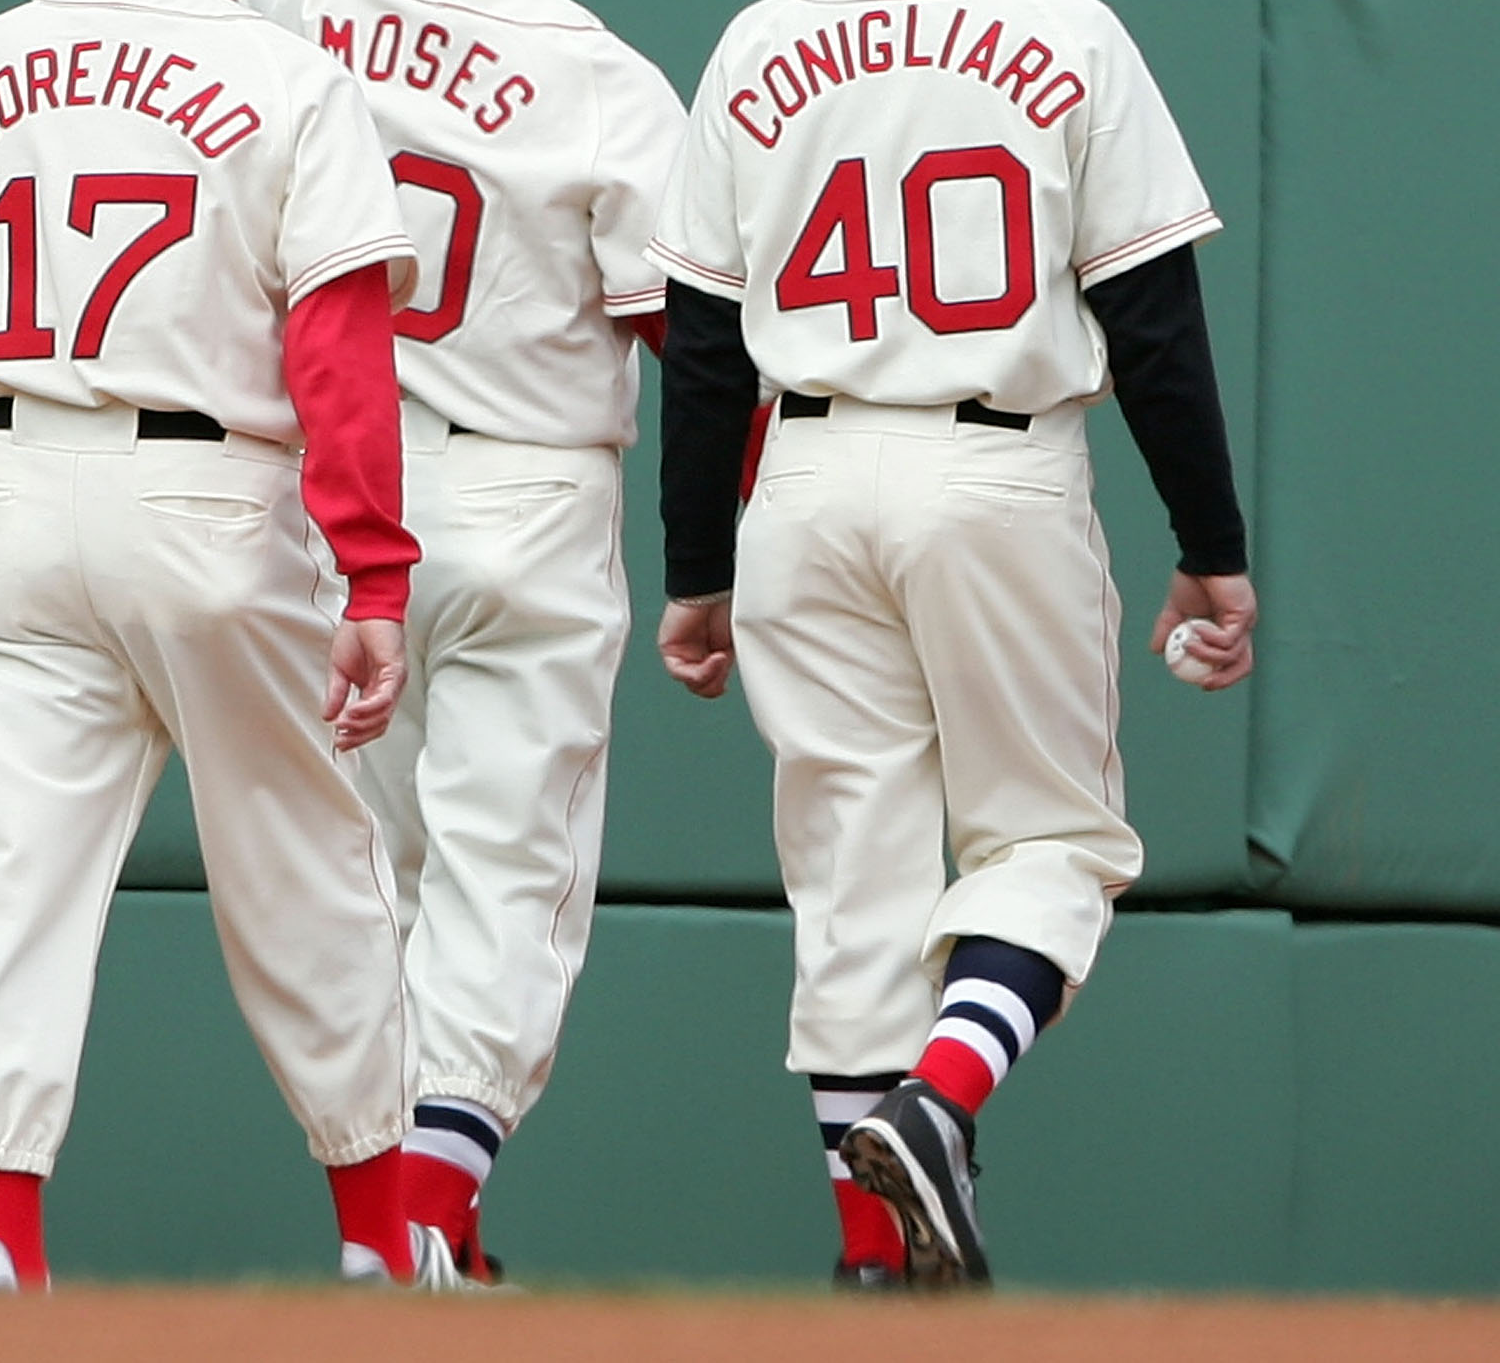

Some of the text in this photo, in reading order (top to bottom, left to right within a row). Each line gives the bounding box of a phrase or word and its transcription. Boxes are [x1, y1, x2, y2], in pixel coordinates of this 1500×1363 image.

[320, 14, 536, 134] MOSES
[727, 3, 1086, 150] CONIGLIARO
[775, 144, 1038, 343] 40
